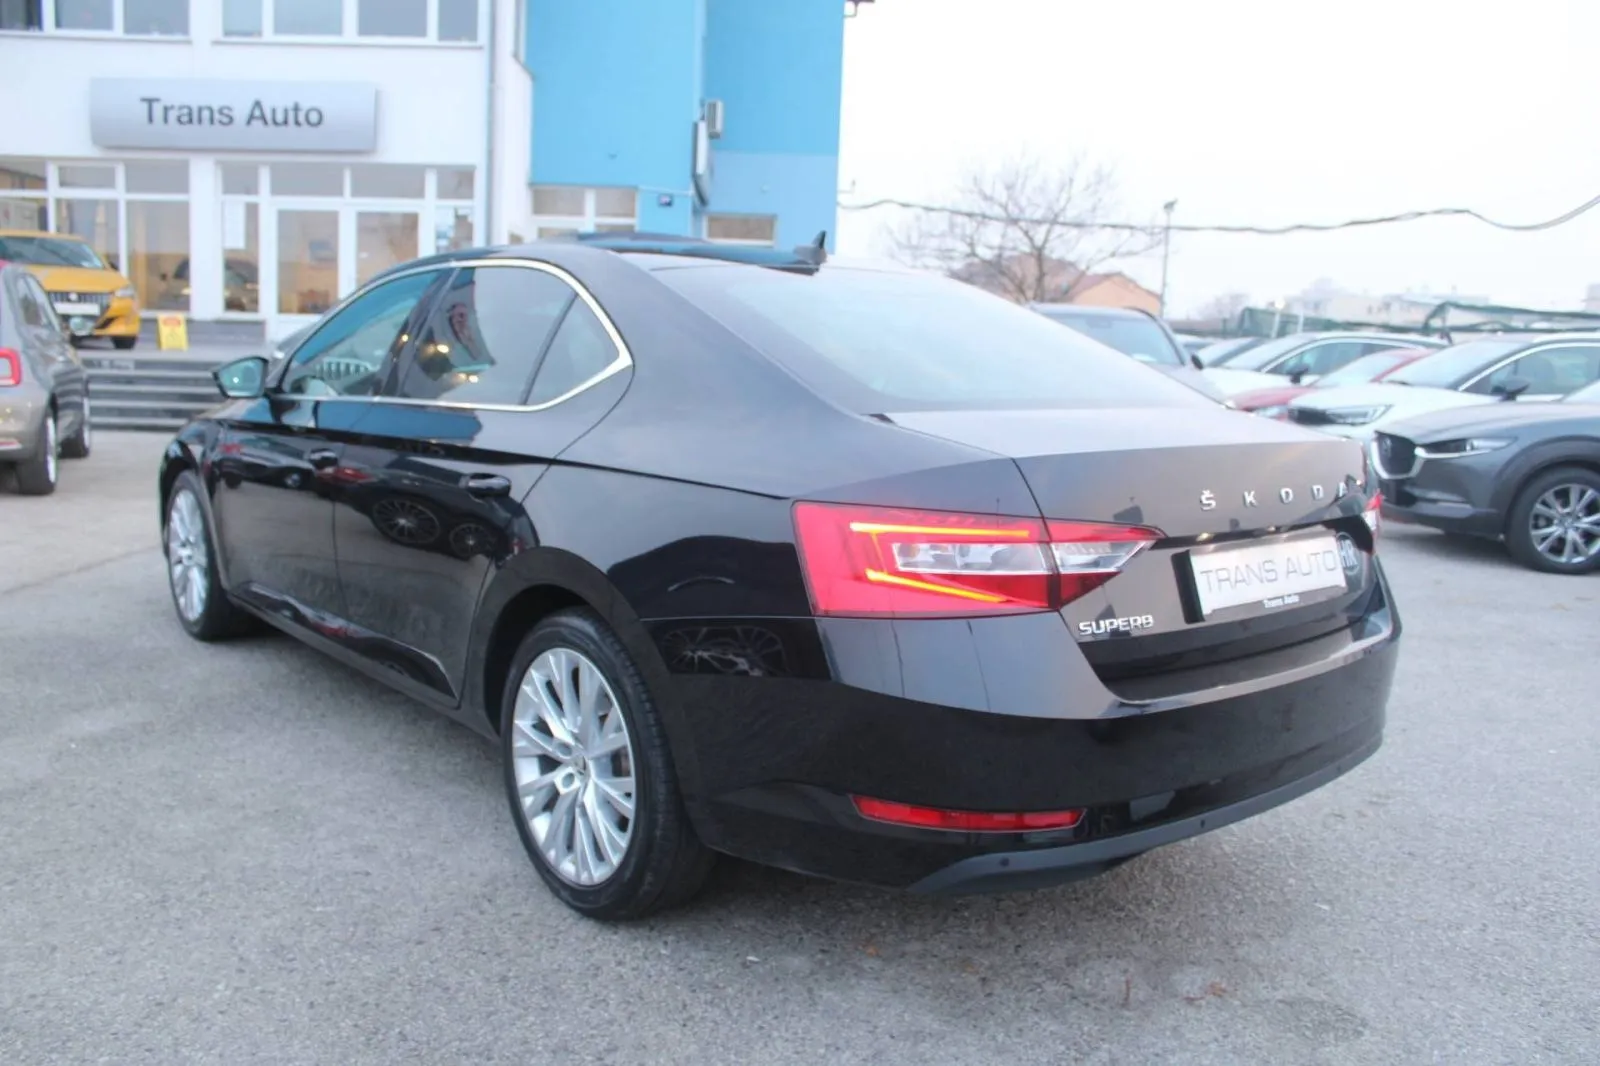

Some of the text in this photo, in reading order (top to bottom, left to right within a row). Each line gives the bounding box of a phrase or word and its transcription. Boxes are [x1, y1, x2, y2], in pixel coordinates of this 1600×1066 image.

[140, 97, 325, 128] Trans Auto
[1199, 549, 1338, 593] TRANS AUTO
[1078, 614, 1154, 636] SUPERB
